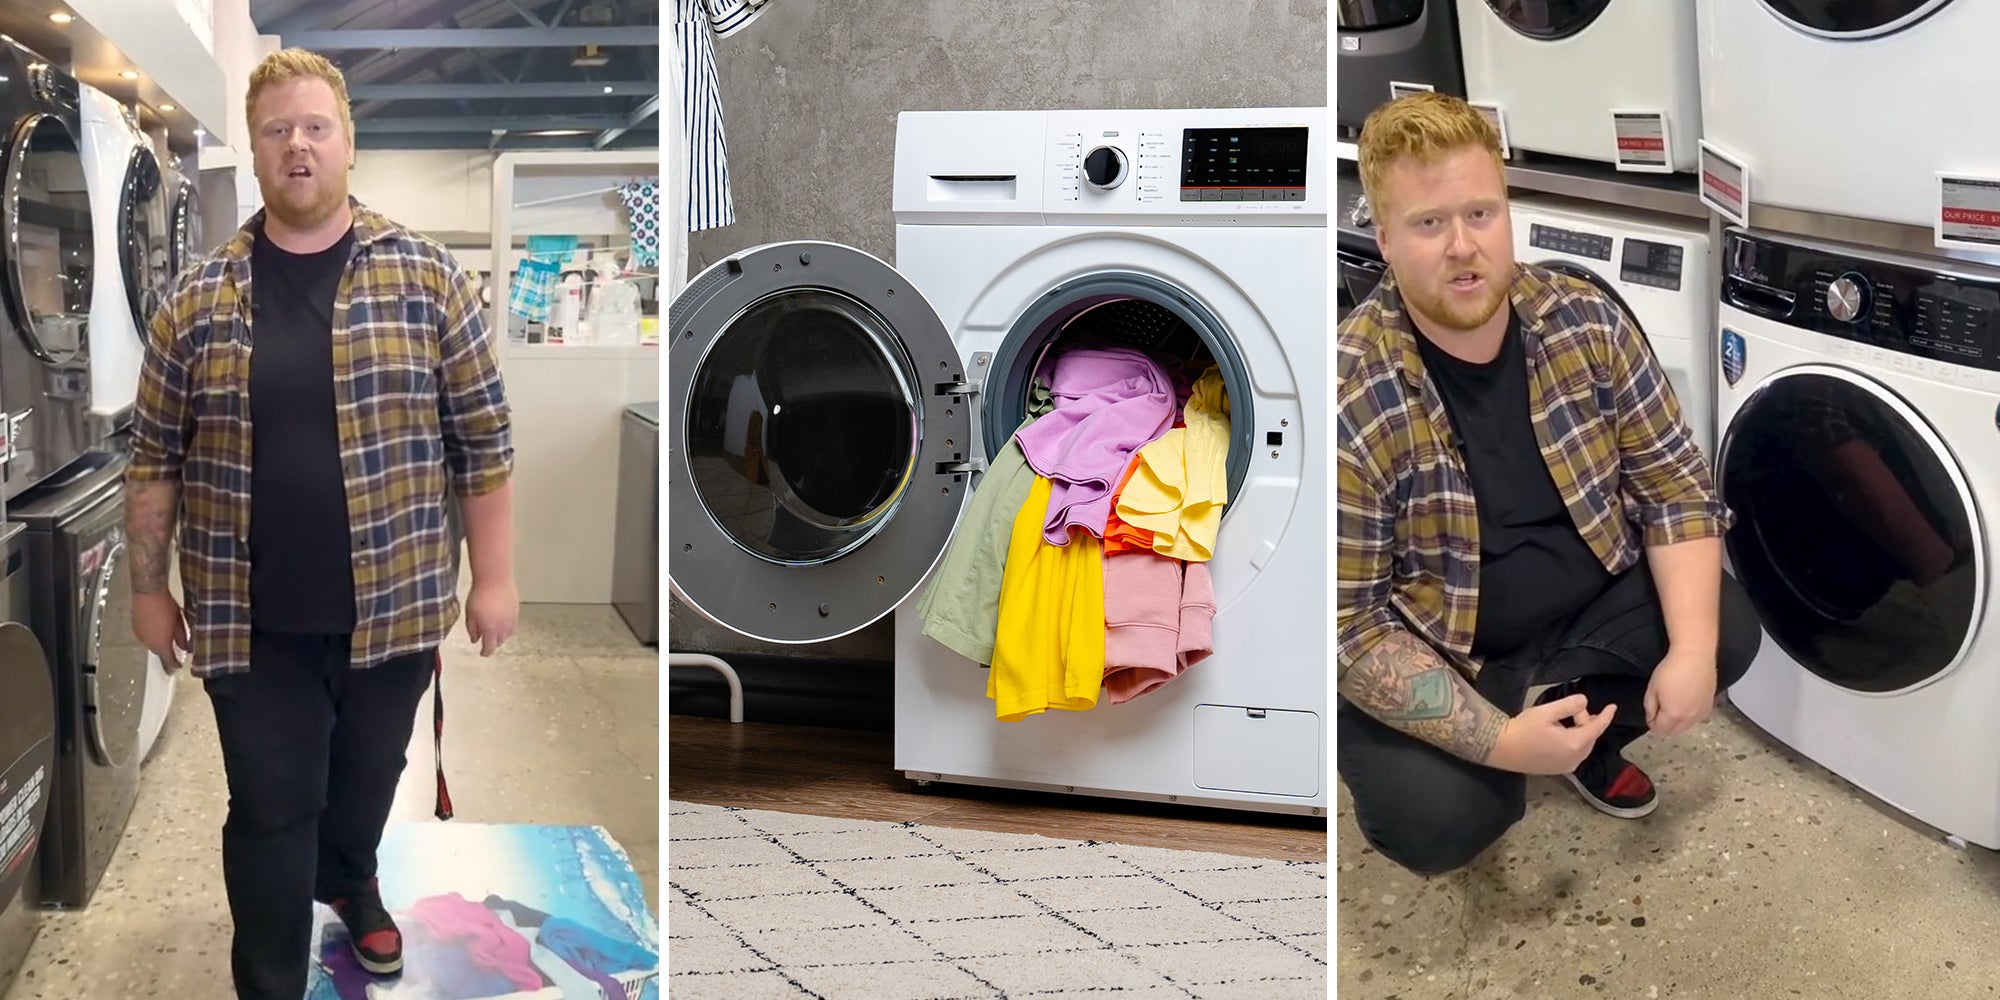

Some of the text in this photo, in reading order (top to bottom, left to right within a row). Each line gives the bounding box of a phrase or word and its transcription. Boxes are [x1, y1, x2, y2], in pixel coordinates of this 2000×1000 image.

[1944, 210, 1961, 220] OUR
[1962, 212, 1985, 222] PRICE
[1725, 341, 1733, 357] 2
